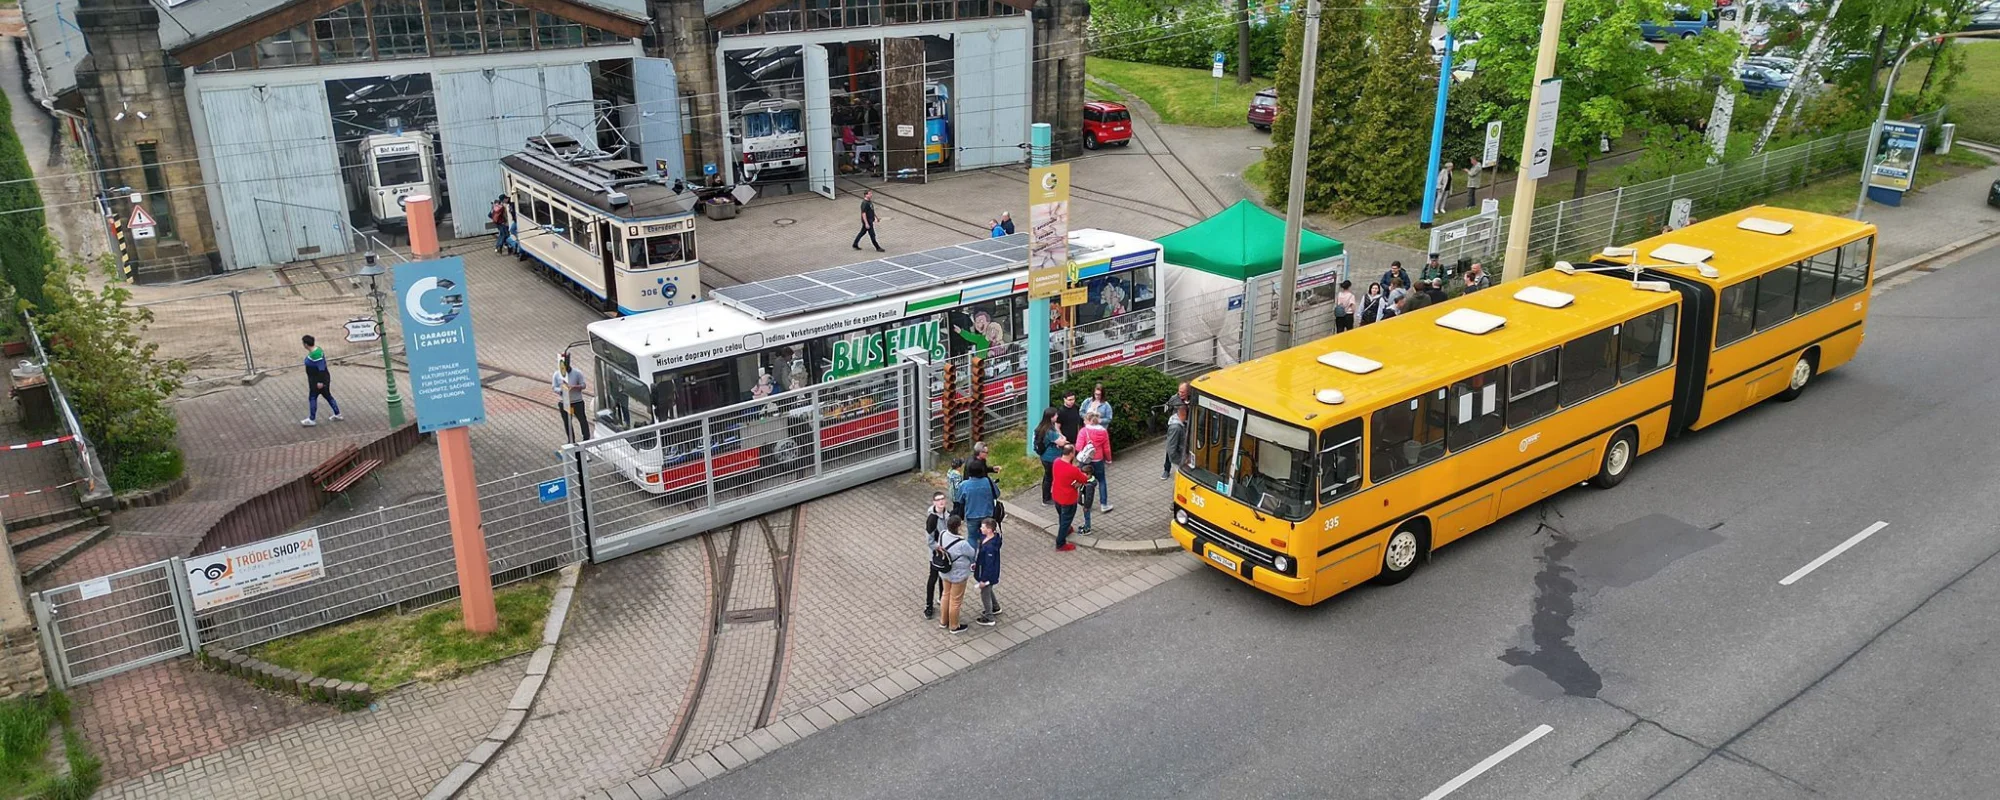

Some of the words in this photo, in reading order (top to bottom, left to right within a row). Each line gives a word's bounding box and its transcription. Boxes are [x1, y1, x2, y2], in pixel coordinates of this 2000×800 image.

[1216, 53, 1222, 61] P
[648, 224, 677, 232] Ebersdorf
[641, 288, 658, 297] 306
[419, 329, 457, 340] GARAGEN
[656, 354, 684, 367] Historie
[684, 349, 711, 361] dopravy
[712, 347, 724, 356] pro
[724, 342, 743, 352] celou
[765, 331, 786, 343] rodinu
[790, 320, 843, 338] Verkehrsgeschichte
[844, 318, 852, 327] für
[853, 316, 862, 325] die
[862, 314, 878, 325] ganze
[878, 309, 897, 319] Familie
[420, 336, 458, 348] CAMPUS
[831, 320, 940, 372] BUSEUM
[428, 362, 460, 372] ZENTRALER
[421, 368, 470, 380] KULTURSTANDORT
[449, 381, 475, 391] SACHSEN
[443, 390, 465, 398] EUROPA
[1191, 493, 1206, 508] 335
[1324, 516, 1339, 531] 335
[235, 538, 314, 568] TRÖDELSHOP24
